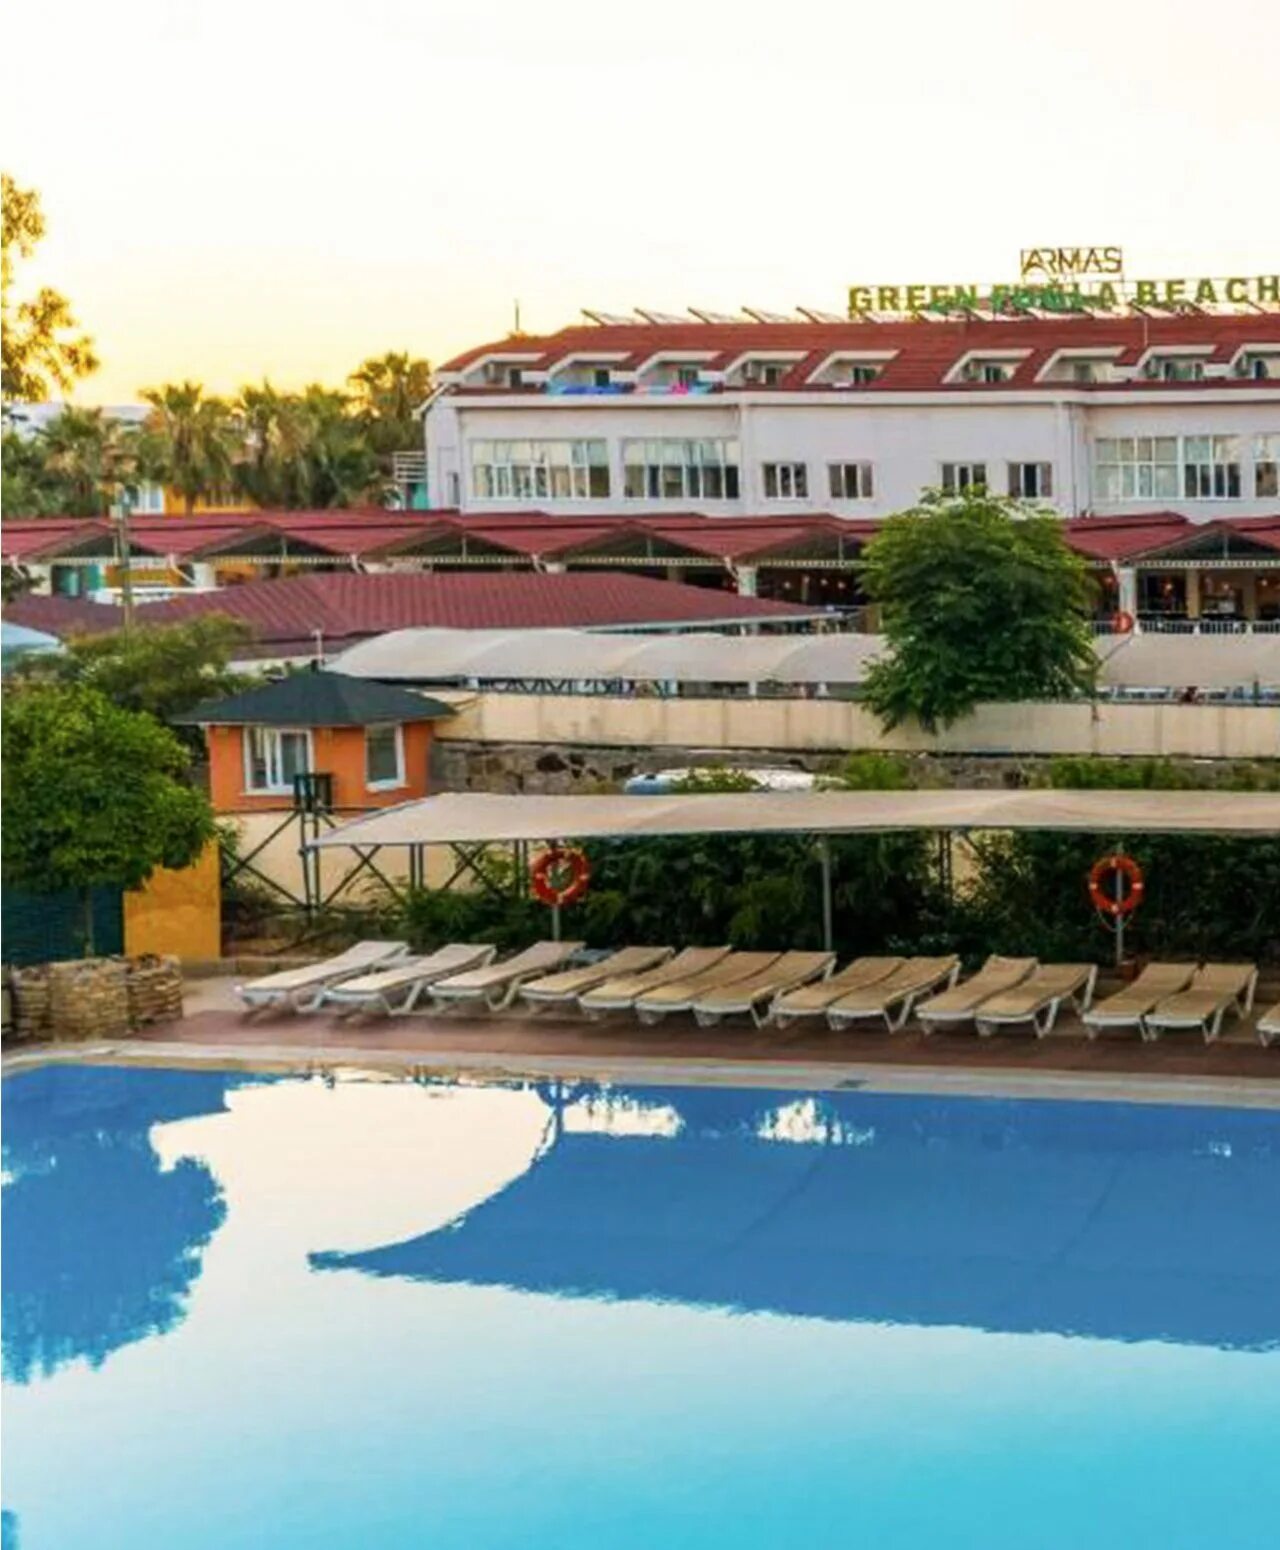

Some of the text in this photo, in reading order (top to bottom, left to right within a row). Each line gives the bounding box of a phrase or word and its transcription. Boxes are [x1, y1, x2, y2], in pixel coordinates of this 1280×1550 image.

[1022, 246, 1122, 275] ARMAS
[848, 284, 977, 313] GREEN
[1135, 275, 1280, 306] BEACH
